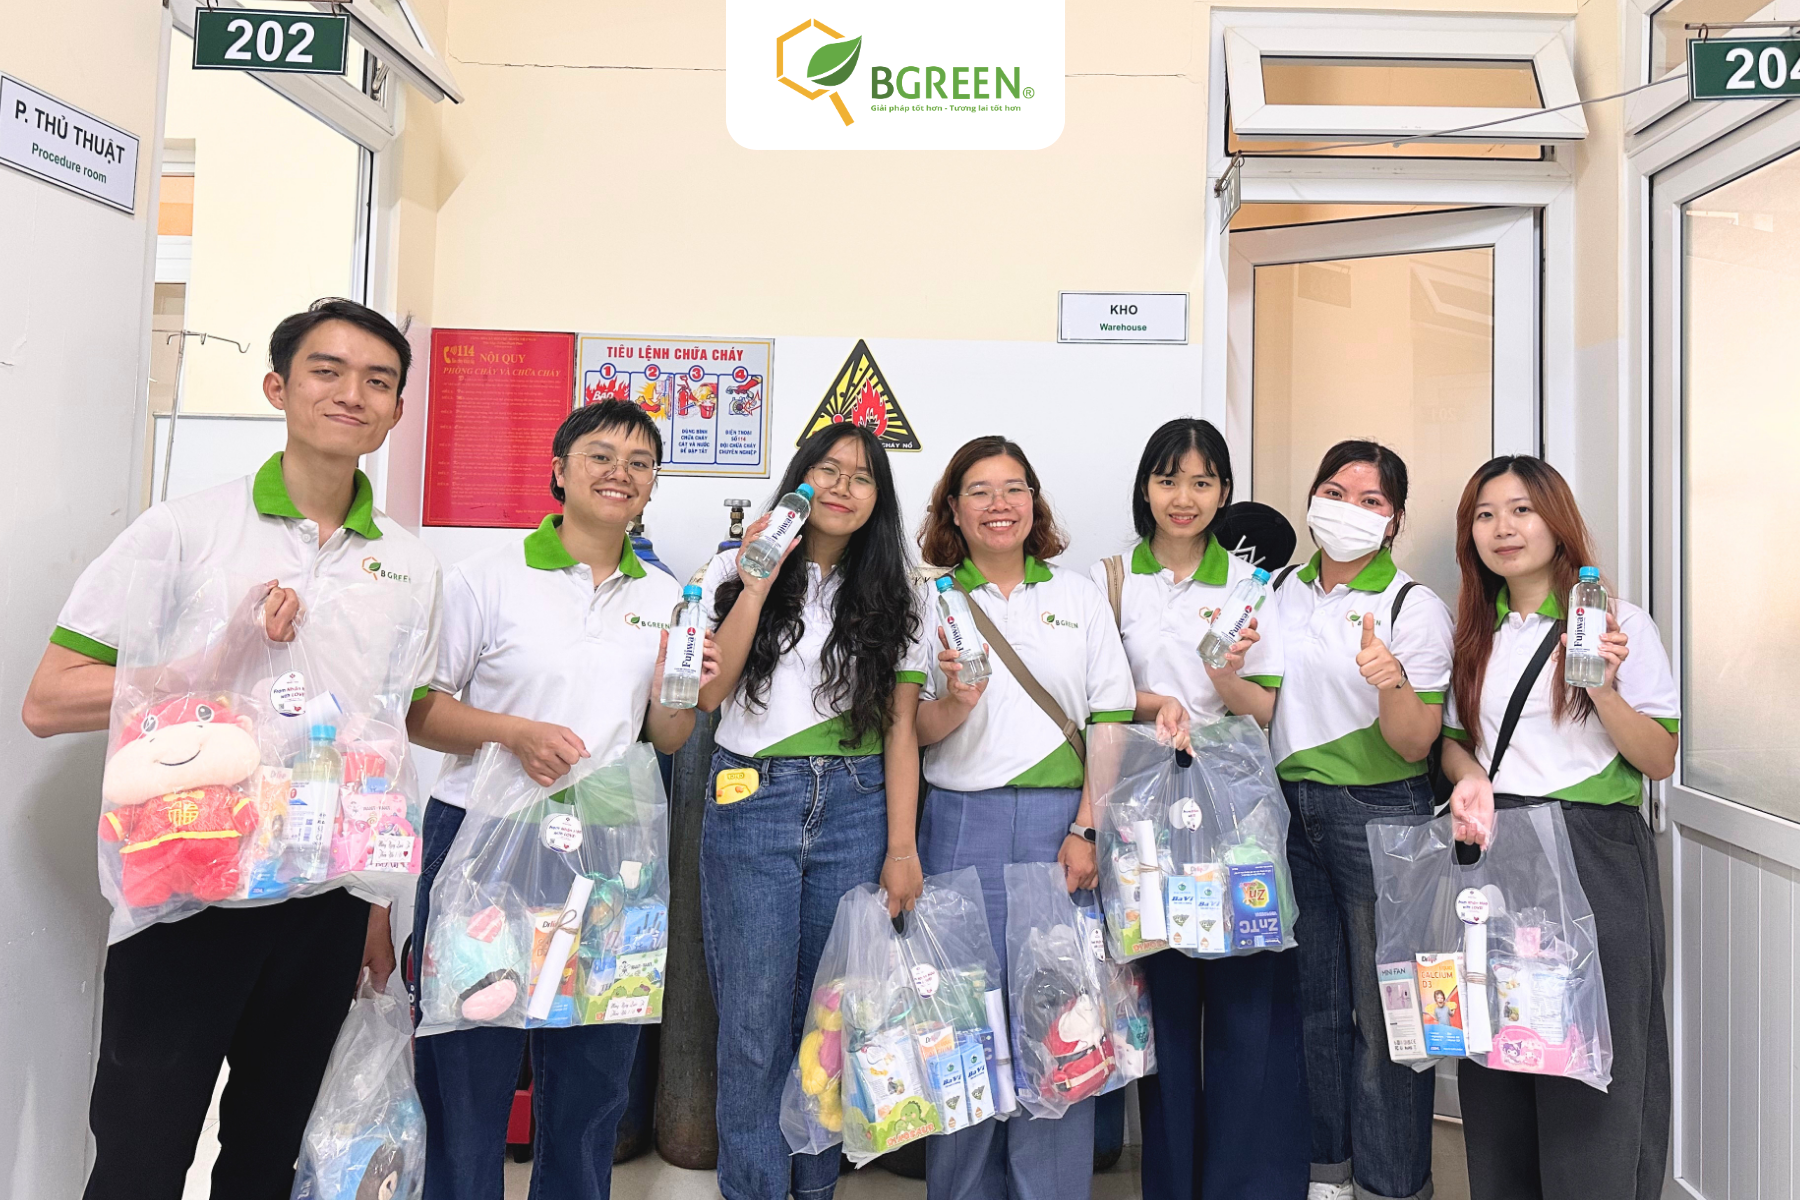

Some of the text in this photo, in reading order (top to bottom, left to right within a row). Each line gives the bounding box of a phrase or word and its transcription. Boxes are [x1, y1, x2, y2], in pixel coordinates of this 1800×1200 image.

[224, 18, 316, 63] 202
[15, 99, 125, 165] P. THỦ THUẬT
[31, 142, 107, 184] Procedure room
[1110, 304, 1138, 315] KHO
[1099, 323, 1147, 331] Warehouse
[457, 345, 475, 356] 114
[606, 344, 744, 361] TIÊU LỆNH CHỮA CHÁY
[480, 351, 499, 365] NỘI
[501, 352, 526, 365] QUY
[443, 366, 473, 375] PHÒNG
[474, 366, 498, 375] CHÁY
[500, 367, 511, 376] VÀ
[537, 368, 561, 378] CHÁY
[603, 365, 611, 377] 1
[648, 366, 658, 377] 2
[691, 367, 701, 379] 3
[735, 369, 746, 380] 4
[1574, 616, 1586, 647] Fujiwa
[681, 636, 694, 668] Fujiwa
[1239, 918, 1278, 933] ZnTC
[1393, 967, 1406, 975] FAN
[1421, 971, 1453, 979] CALCIUM
[1422, 980, 1432, 988] D3
